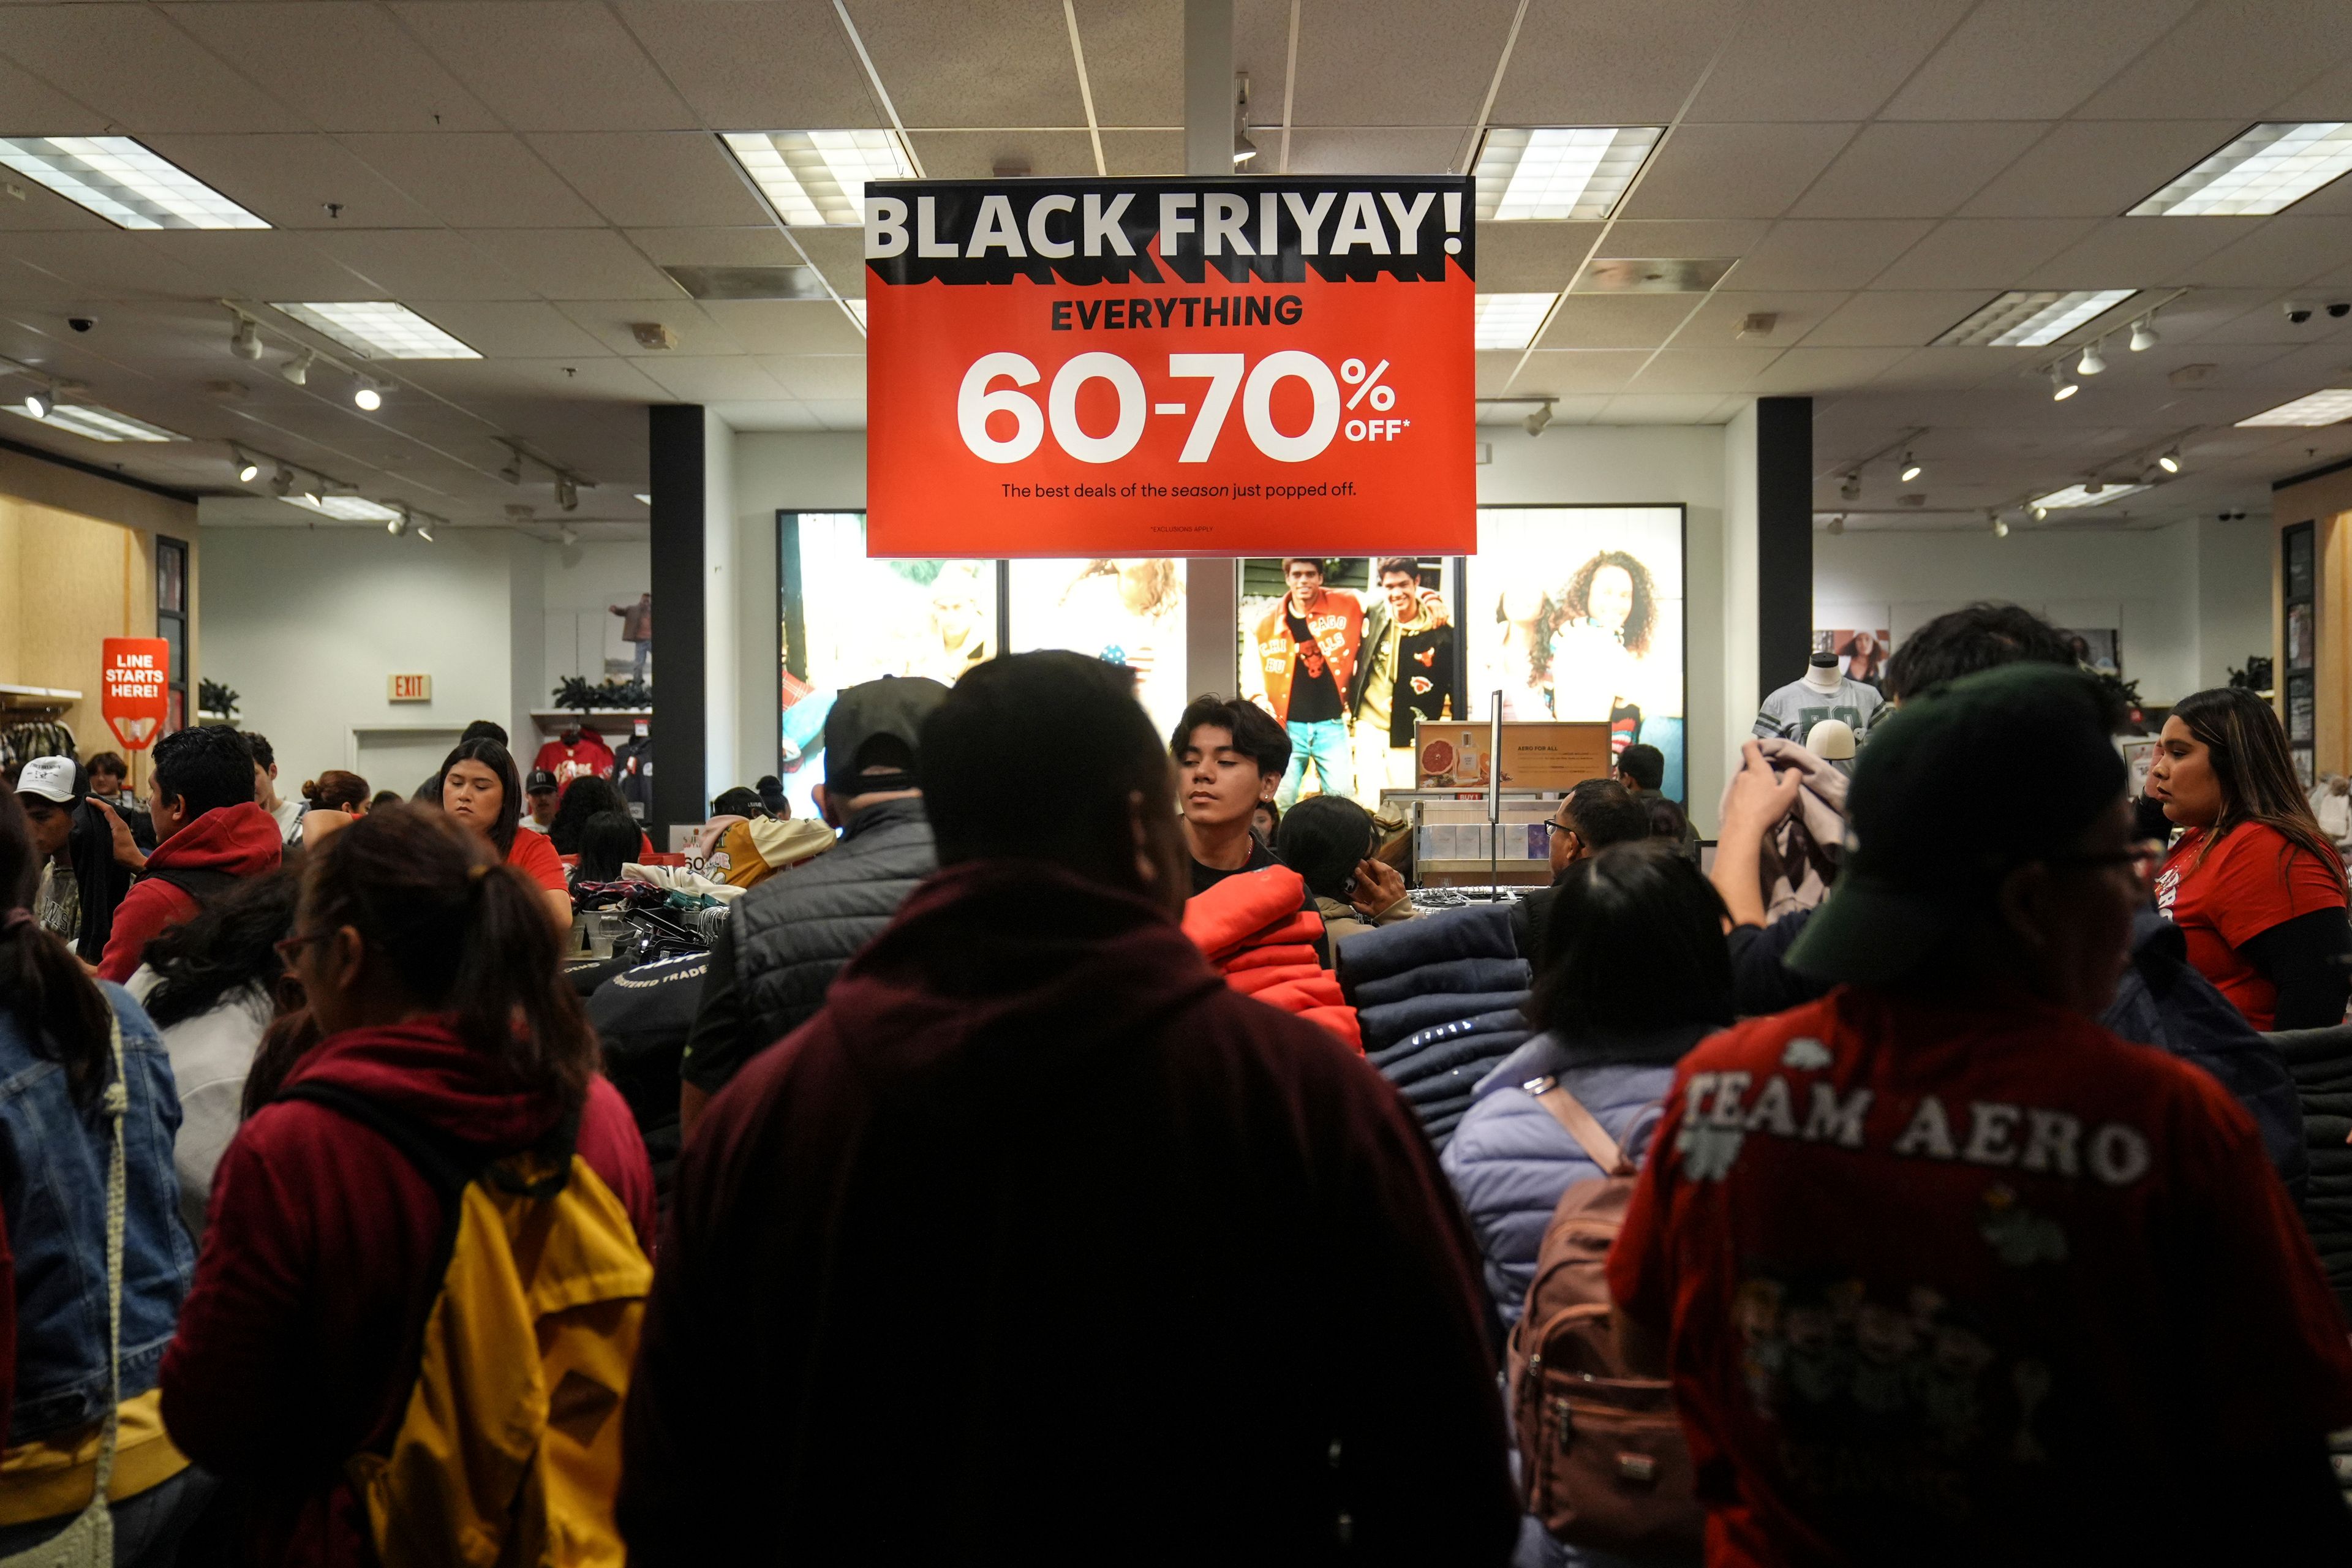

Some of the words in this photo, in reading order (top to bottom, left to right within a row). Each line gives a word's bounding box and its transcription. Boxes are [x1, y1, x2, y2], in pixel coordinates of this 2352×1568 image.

[865, 194, 1137, 260] BLACK
[1160, 192, 1463, 256] FRIYAY!
[1051, 295, 1303, 331] EVERYTHING
[1002, 483, 1031, 497] The
[1036, 484, 1069, 497] best
[1074, 483, 1117, 497] deals
[1120, 483, 1137, 497] of
[1141, 483, 1167, 497] the
[1171, 487, 1229, 497] season
[1232, 483, 1261, 500] just
[1265, 483, 1327, 500] popped
[1331, 481, 1357, 496] off.
[116, 654, 154, 668] LINE
[106, 668, 165, 684] STARTS
[396, 676, 423, 696] EXIT
[111, 684, 159, 698] HERE!
[663, 963, 709, 983] TRADE
[1683, 1071, 1874, 1145] TEAM
[1894, 1096, 2149, 1185] AERO
